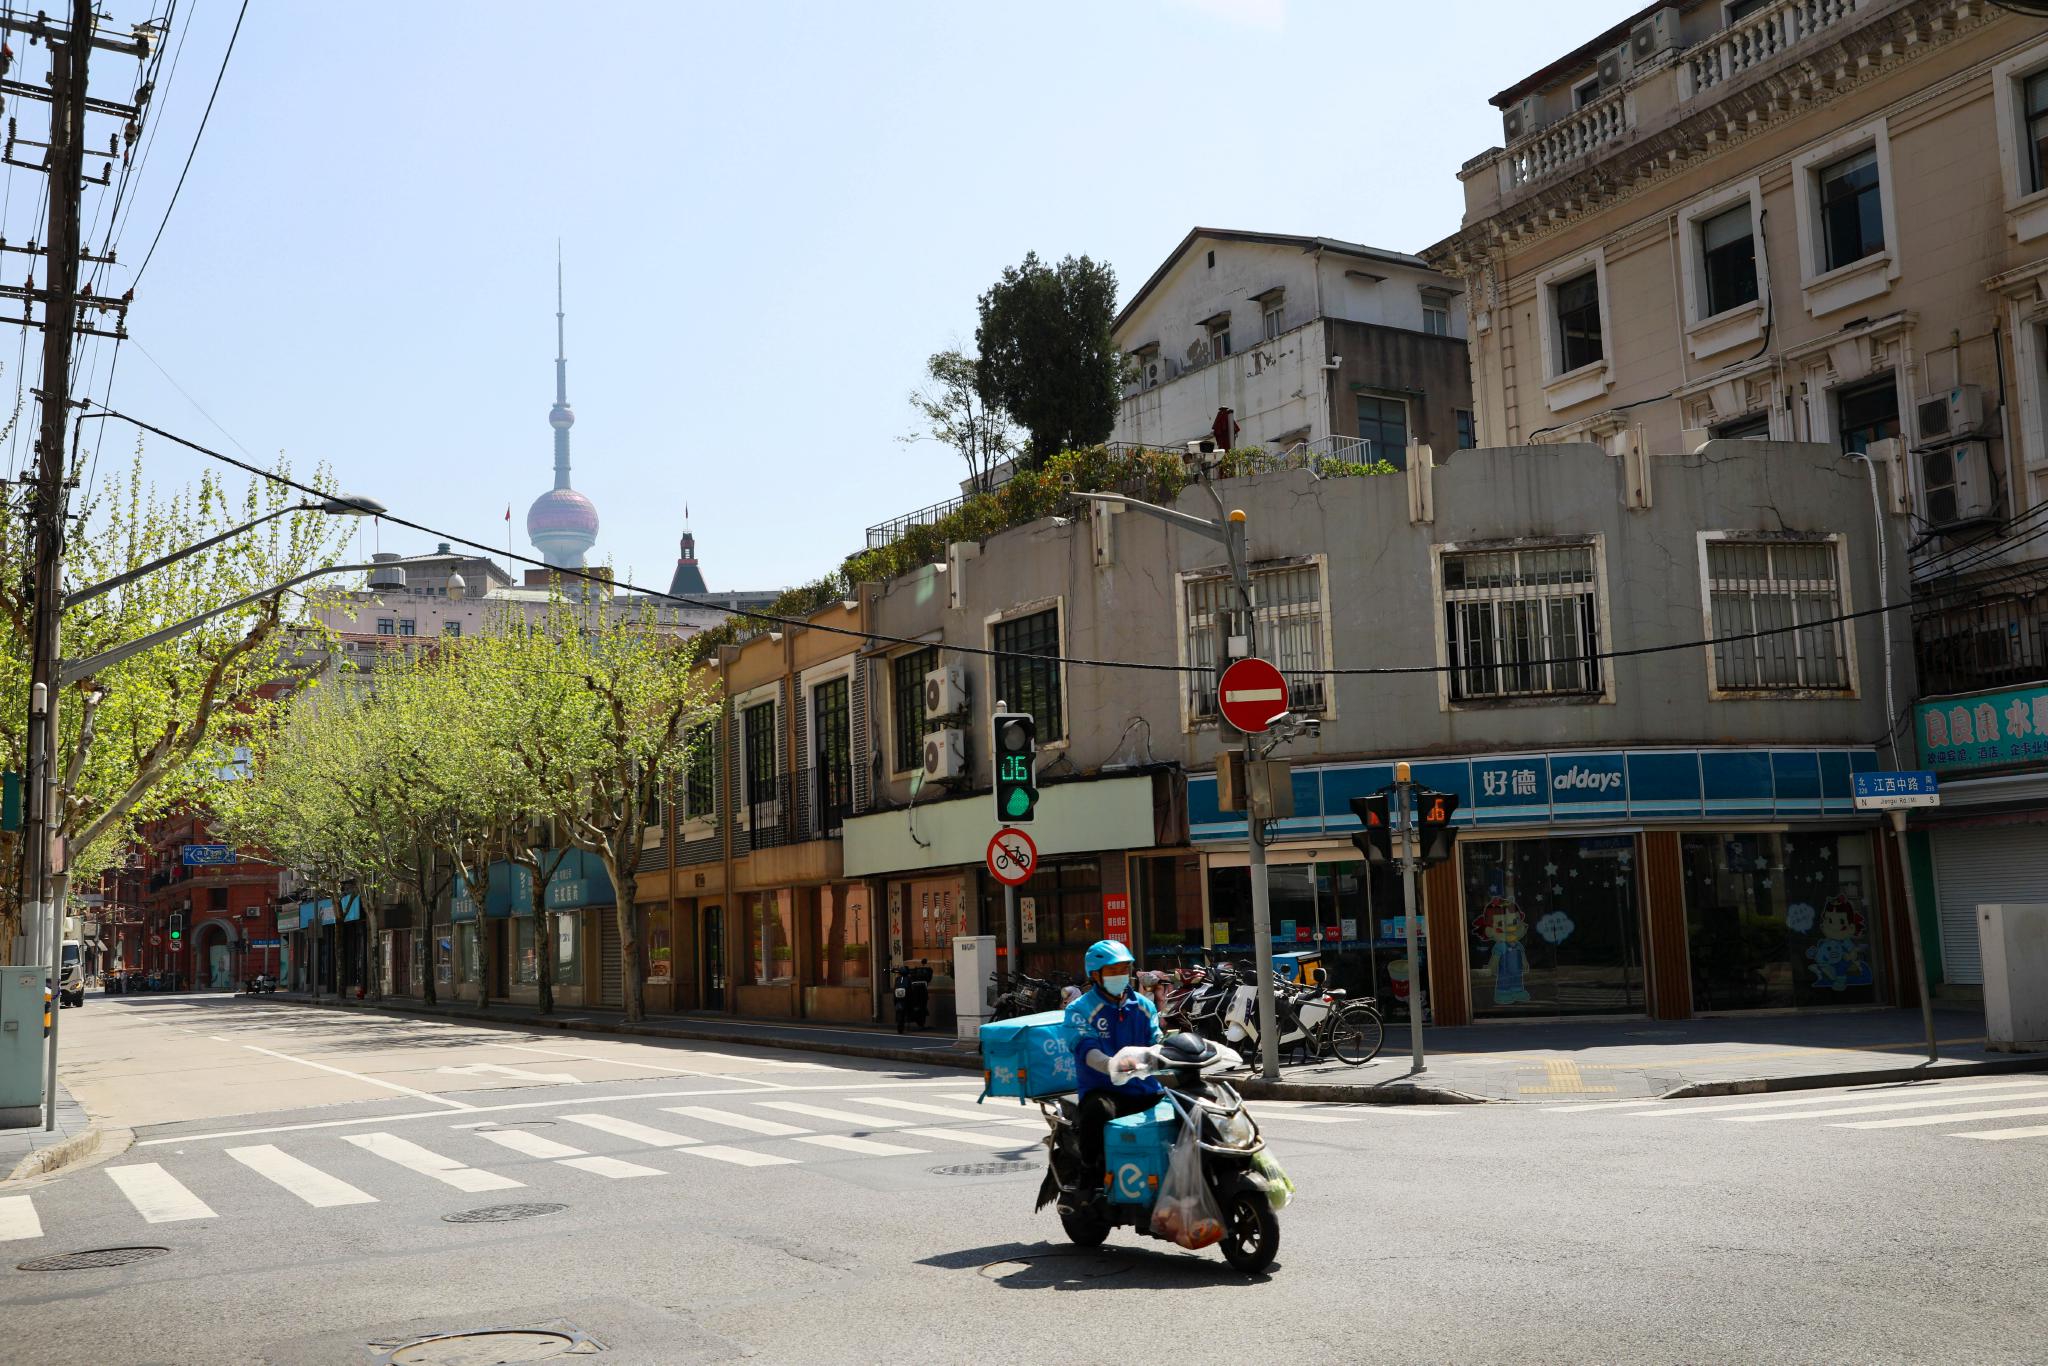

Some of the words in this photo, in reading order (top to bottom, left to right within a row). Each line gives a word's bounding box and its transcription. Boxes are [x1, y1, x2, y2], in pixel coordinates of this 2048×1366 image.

[1483, 769, 1537, 796] 好德
[1553, 765, 1623, 792] alldays
[1873, 776, 1919, 792] 江西中路
[1861, 798, 1867, 806] N
[1929, 796, 1935, 804] S
